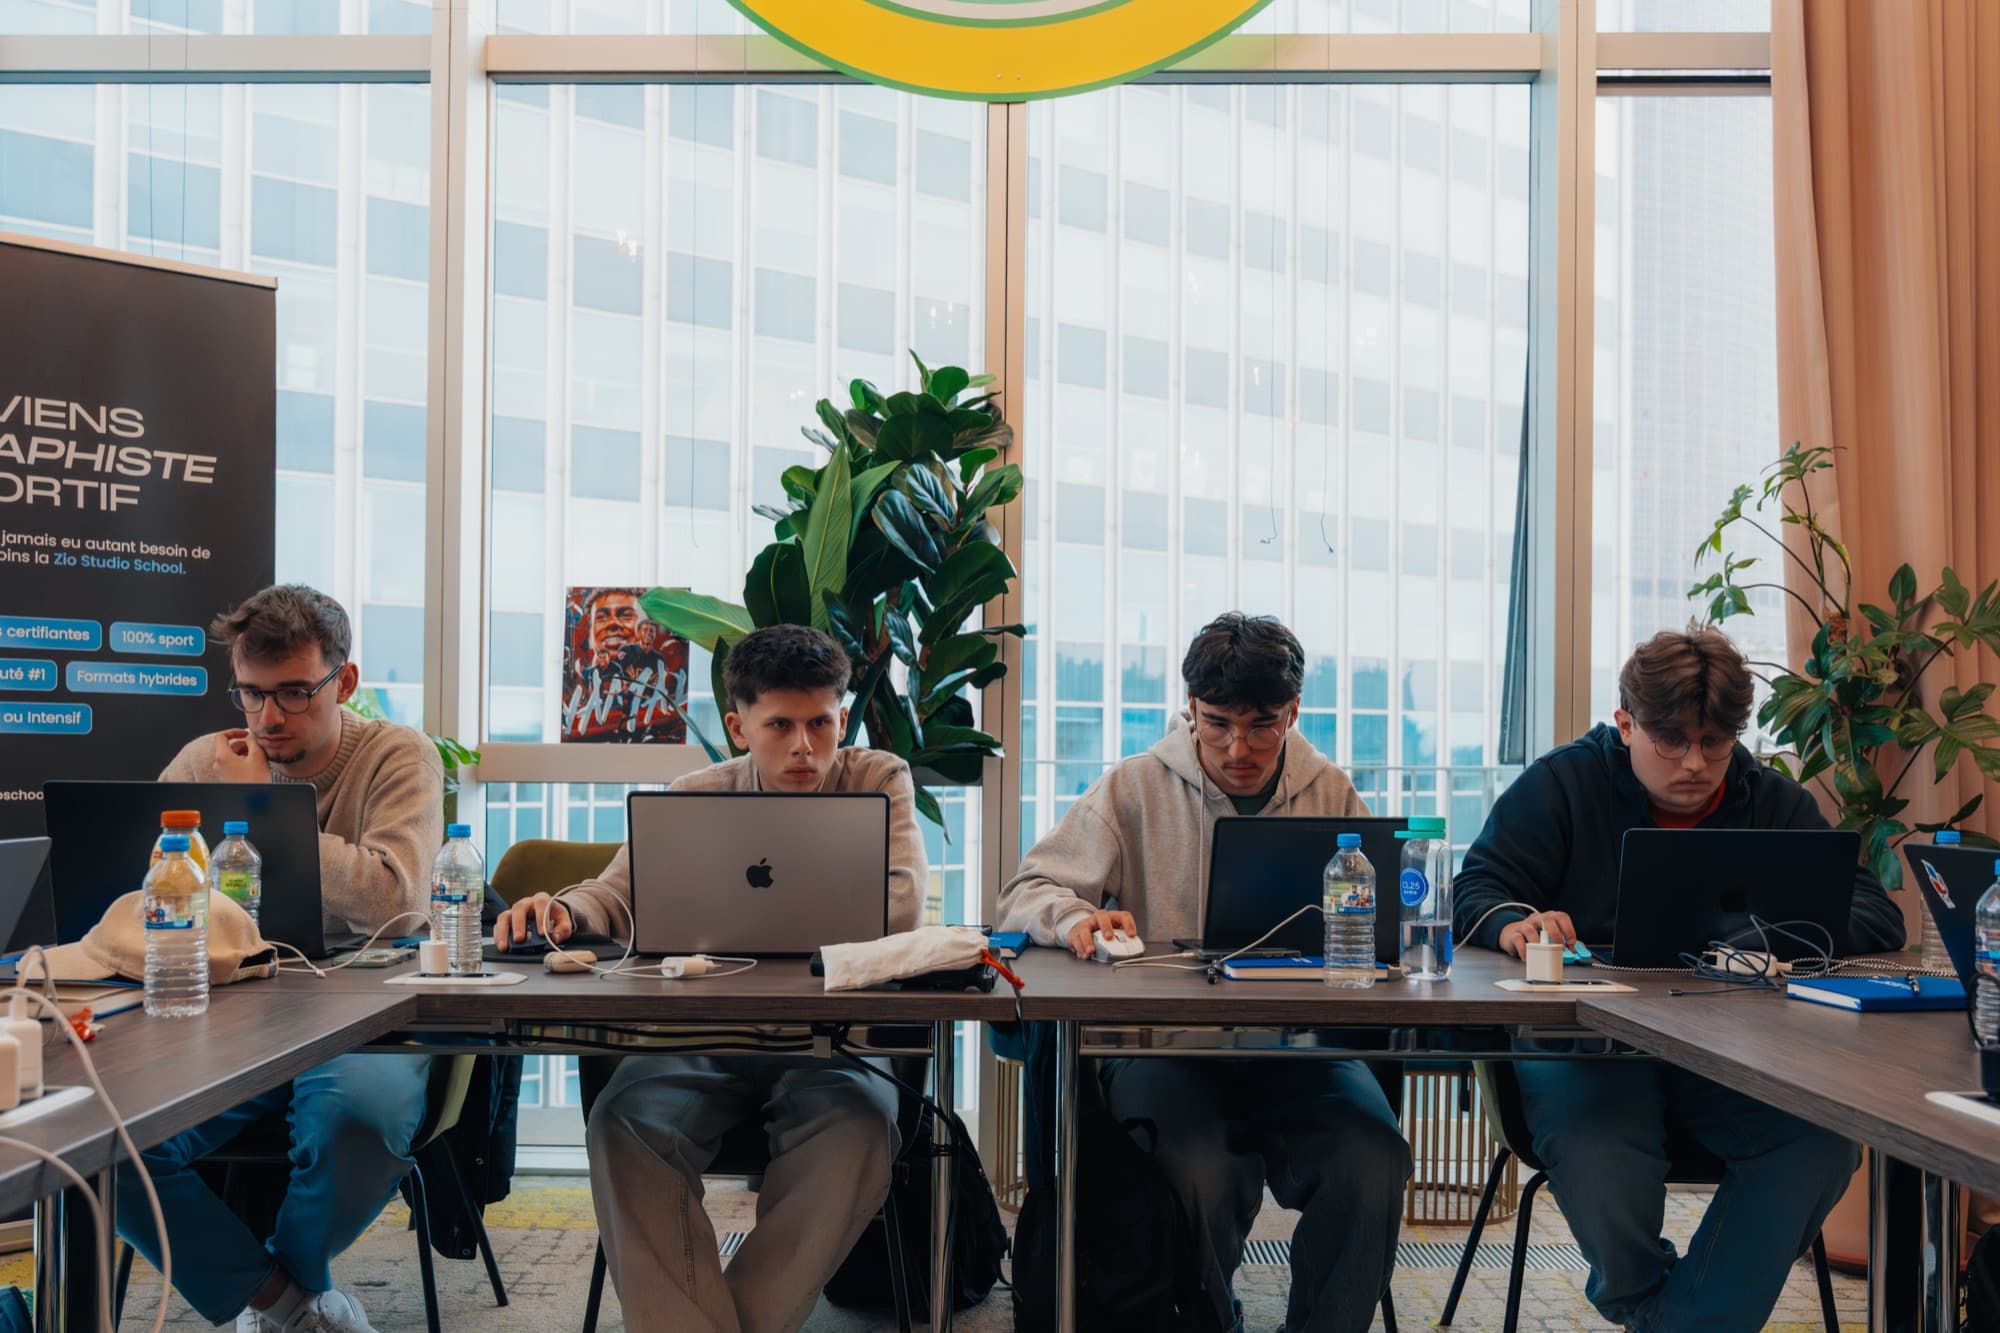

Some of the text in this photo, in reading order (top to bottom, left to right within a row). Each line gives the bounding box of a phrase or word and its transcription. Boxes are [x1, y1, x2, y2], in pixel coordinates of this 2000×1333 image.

[0, 433, 217, 484] APHISTE
[1, 529, 211, 559] jamais eu autant besoin de
[0, 548, 187, 575] oins la Zio Studio School.
[7, 625, 90, 641] certifiantes
[122, 630, 194, 648] 100% sport
[28, 667, 45, 681] #1
[77, 669, 198, 688] Formats hybrides
[3, 711, 81, 725] ou Intensif
